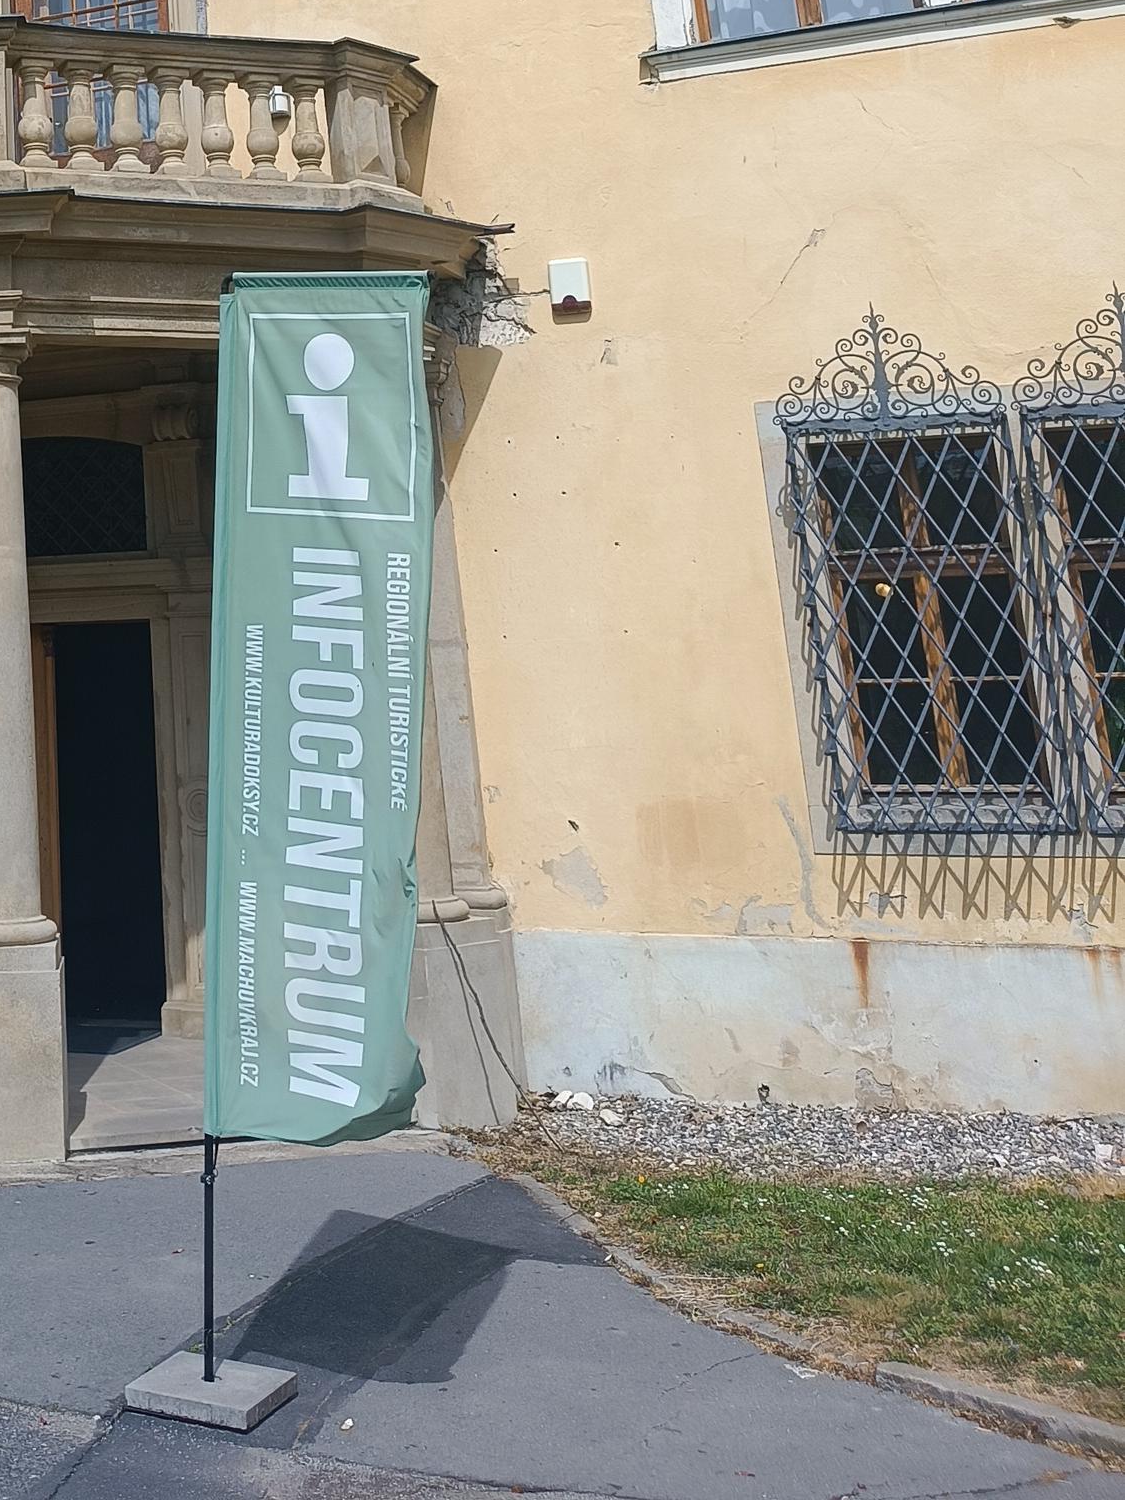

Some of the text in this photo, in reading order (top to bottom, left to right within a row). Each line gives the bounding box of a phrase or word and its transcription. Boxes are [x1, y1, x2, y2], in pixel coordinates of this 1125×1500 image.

[243, 625, 263, 836] WWW.KULTURADOKSY.CZ
[386, 553, 413, 811] REGIONÁLNÍ TURISTICKÉ
[284, 548, 366, 1107] INFOCENTRUM
[239, 882, 258, 1086] WWW.MACHUVKRAJ.CZ
